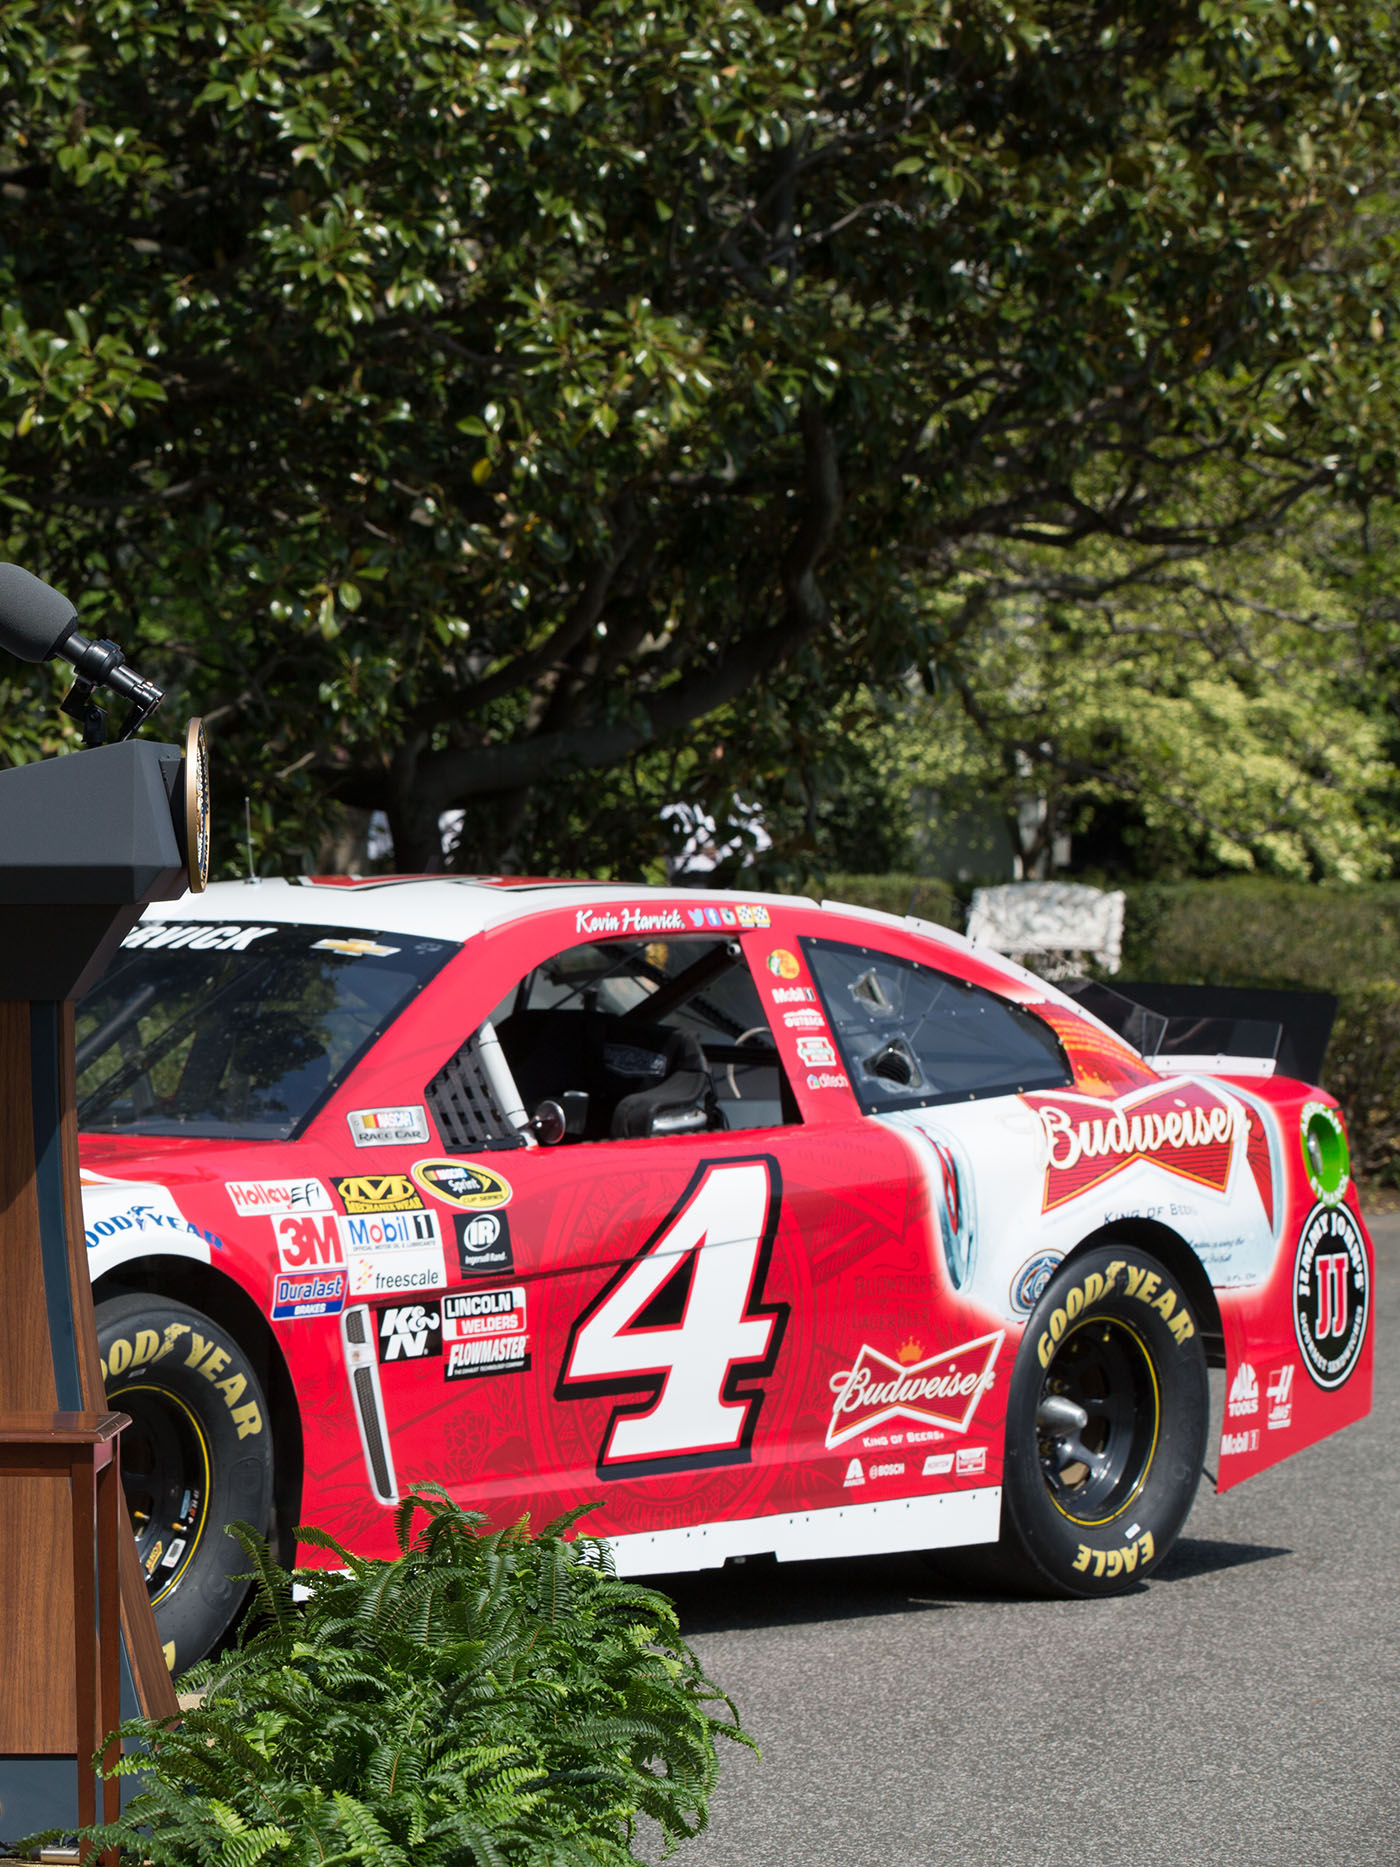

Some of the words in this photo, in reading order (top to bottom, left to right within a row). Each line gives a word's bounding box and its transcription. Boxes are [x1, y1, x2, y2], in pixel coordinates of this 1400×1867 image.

[576, 910, 619, 933] Kevin
[621, 908, 683, 931] Harvick
[119, 926, 278, 951] RVICK
[771, 987, 805, 1004] Mobil
[819, 1073, 848, 1088] ditech
[395, 1130, 421, 1139] CAR
[1036, 1099, 1251, 1170] Budweiser
[229, 1183, 292, 1210] Holley
[291, 1182, 320, 1207] EFI
[448, 1178, 480, 1193] Sprint
[279, 1215, 344, 1267] 3M
[348, 1216, 409, 1245] Mobil
[415, 1214, 432, 1239] 1
[469, 1220, 495, 1246] IR
[1298, 1212, 1329, 1297] JIMMY
[279, 1275, 343, 1302] Duralast
[376, 1269, 439, 1290] freescale
[854, 1273, 939, 1299] BUDWEISER
[446, 1293, 511, 1318] LINCOLN
[1315, 1252, 1349, 1340] JJ
[294, 1303, 326, 1316] BRAKES
[380, 1305, 440, 1337] K&
[558, 1157, 786, 1474] 4
[897, 1305, 931, 1331] BEER
[461, 1314, 518, 1335] WELDERS
[385, 1330, 428, 1360] N
[447, 1339, 527, 1377] FLOWMASTER
[829, 1364, 996, 1415] Budweiser
[1228, 1399, 1259, 1418] TOOLS
[862, 1436, 888, 1448] KING
[890, 1434, 903, 1444] OF
[906, 1431, 941, 1443] BEERS
[1220, 1431, 1249, 1457] Mobil
[1071, 1530, 1155, 1578] EAGLE
